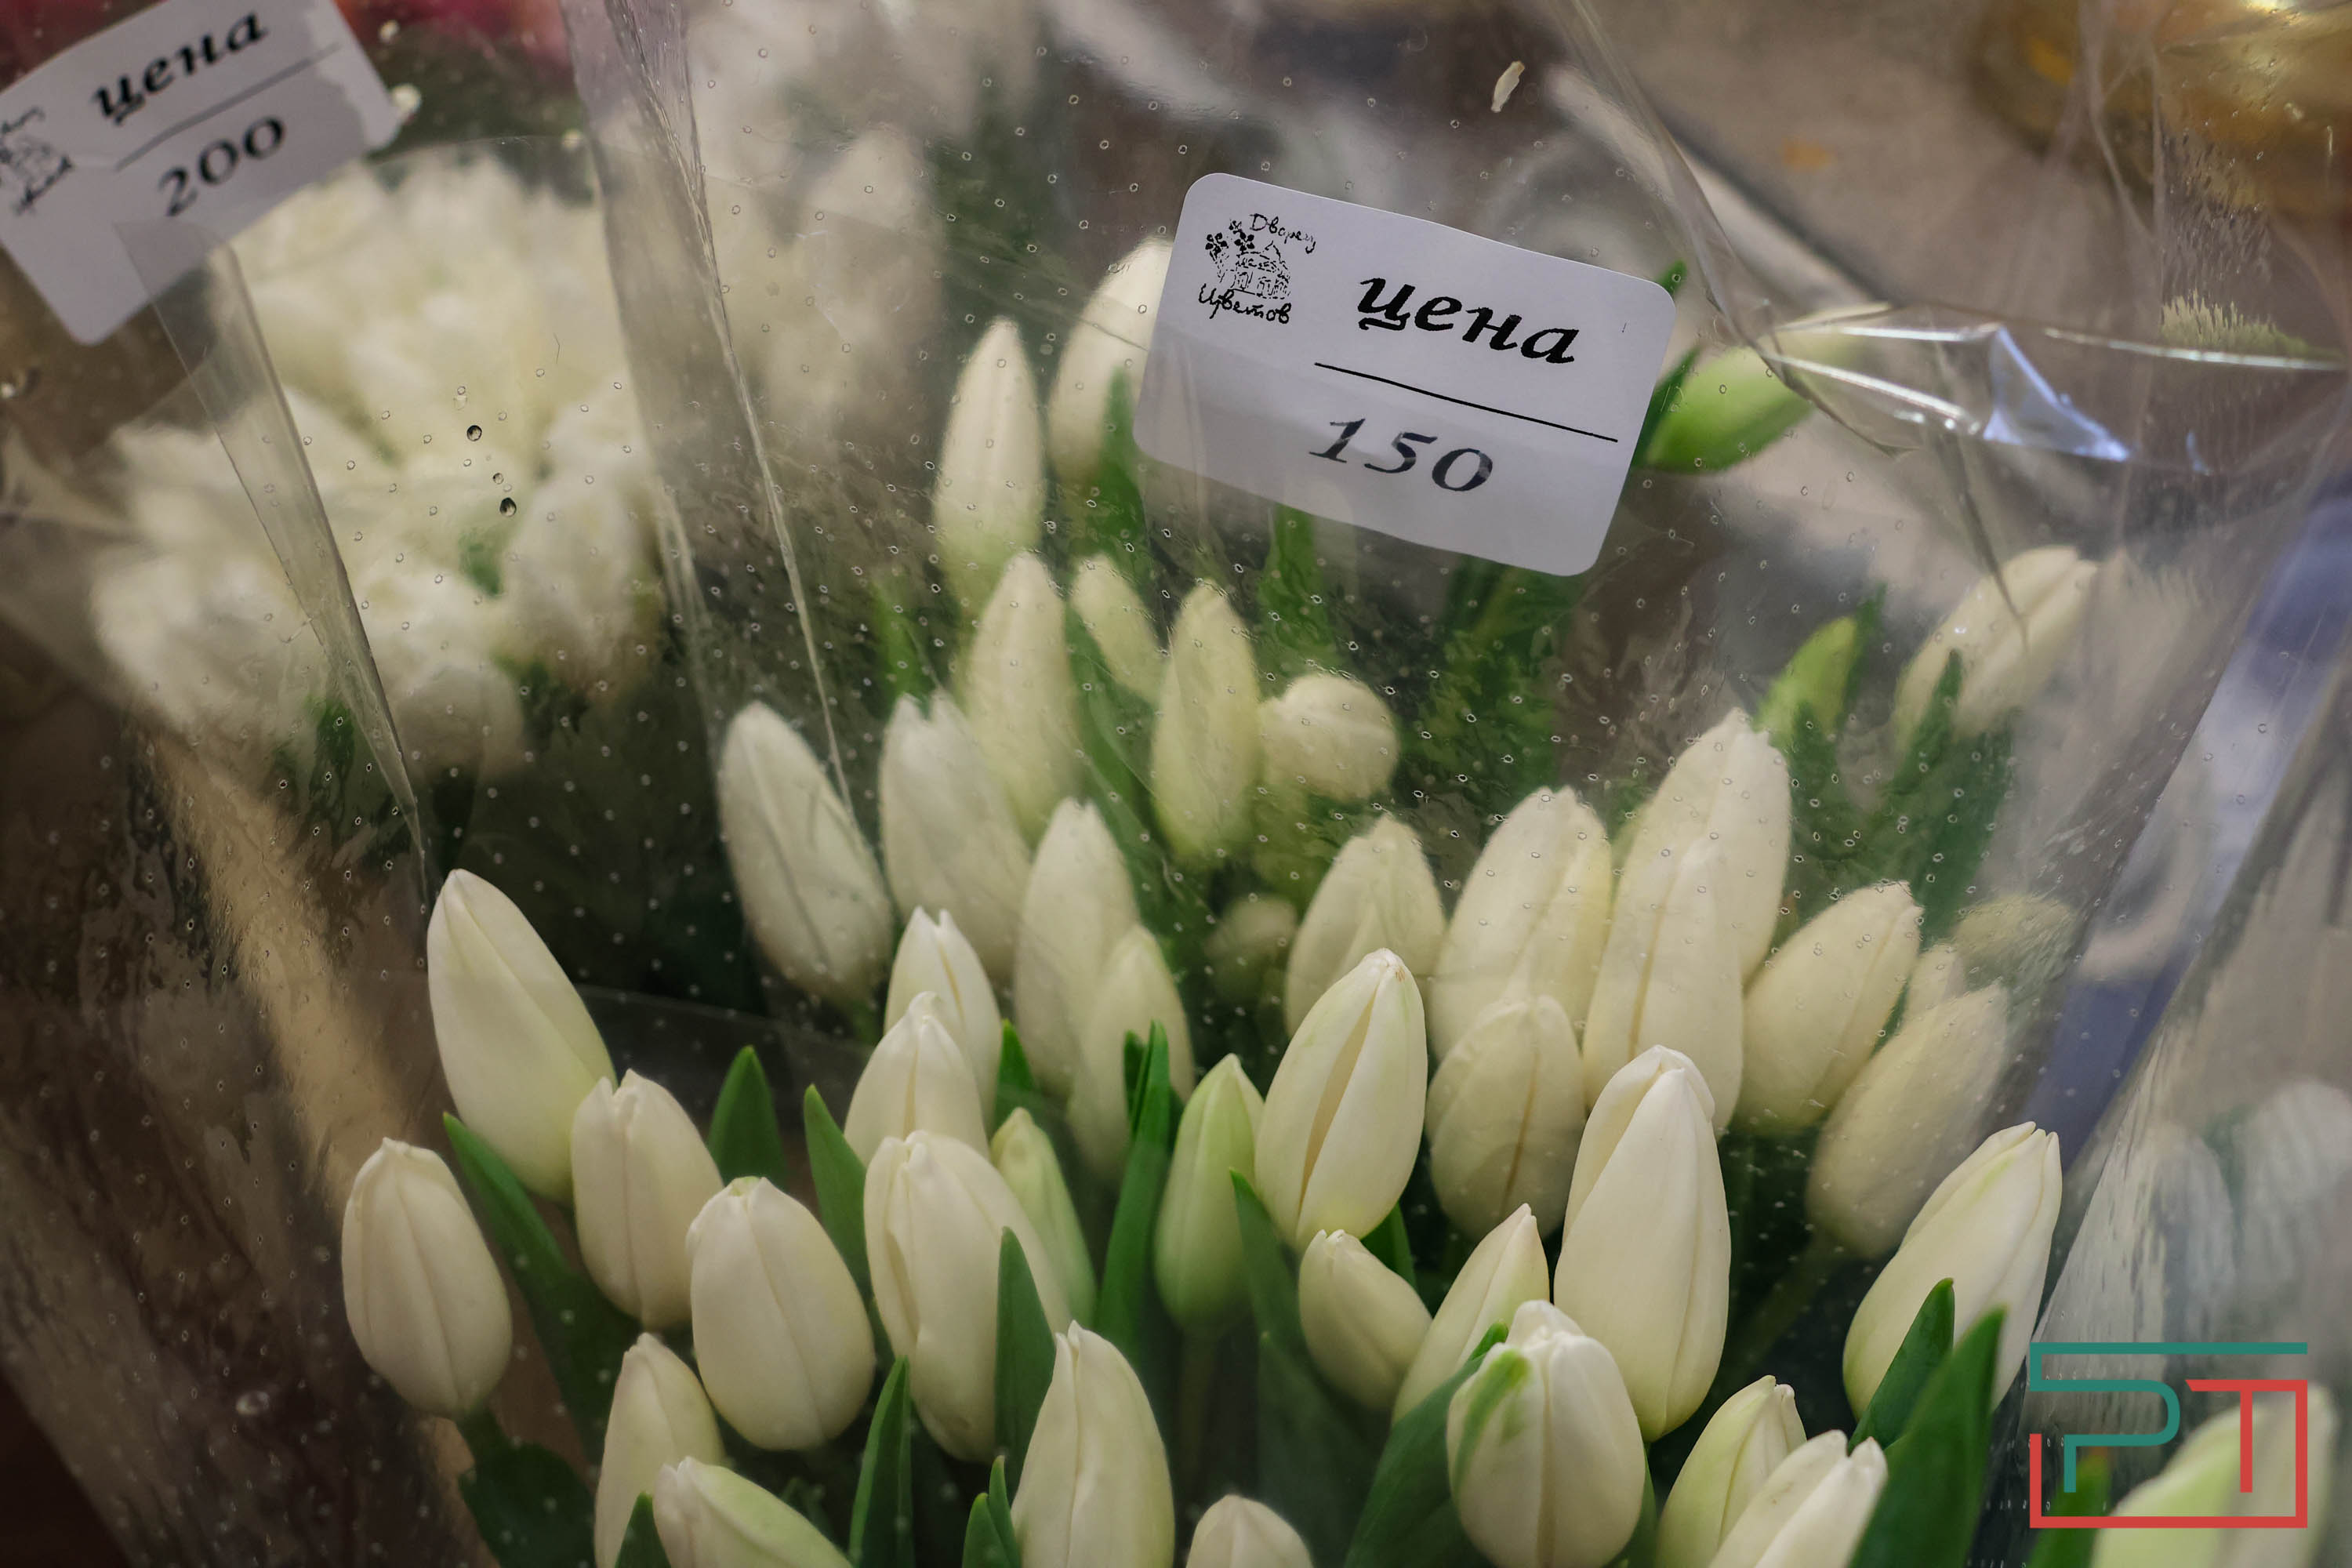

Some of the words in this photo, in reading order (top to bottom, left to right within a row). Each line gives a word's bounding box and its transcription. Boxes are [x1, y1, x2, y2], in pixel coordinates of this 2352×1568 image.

[91, 12, 269, 126] цена
[159, 116, 286, 217] 200
[1198, 283, 1293, 325] Цветов
[1357, 277, 1581, 365] цена
[1308, 417, 1494, 492] 150
